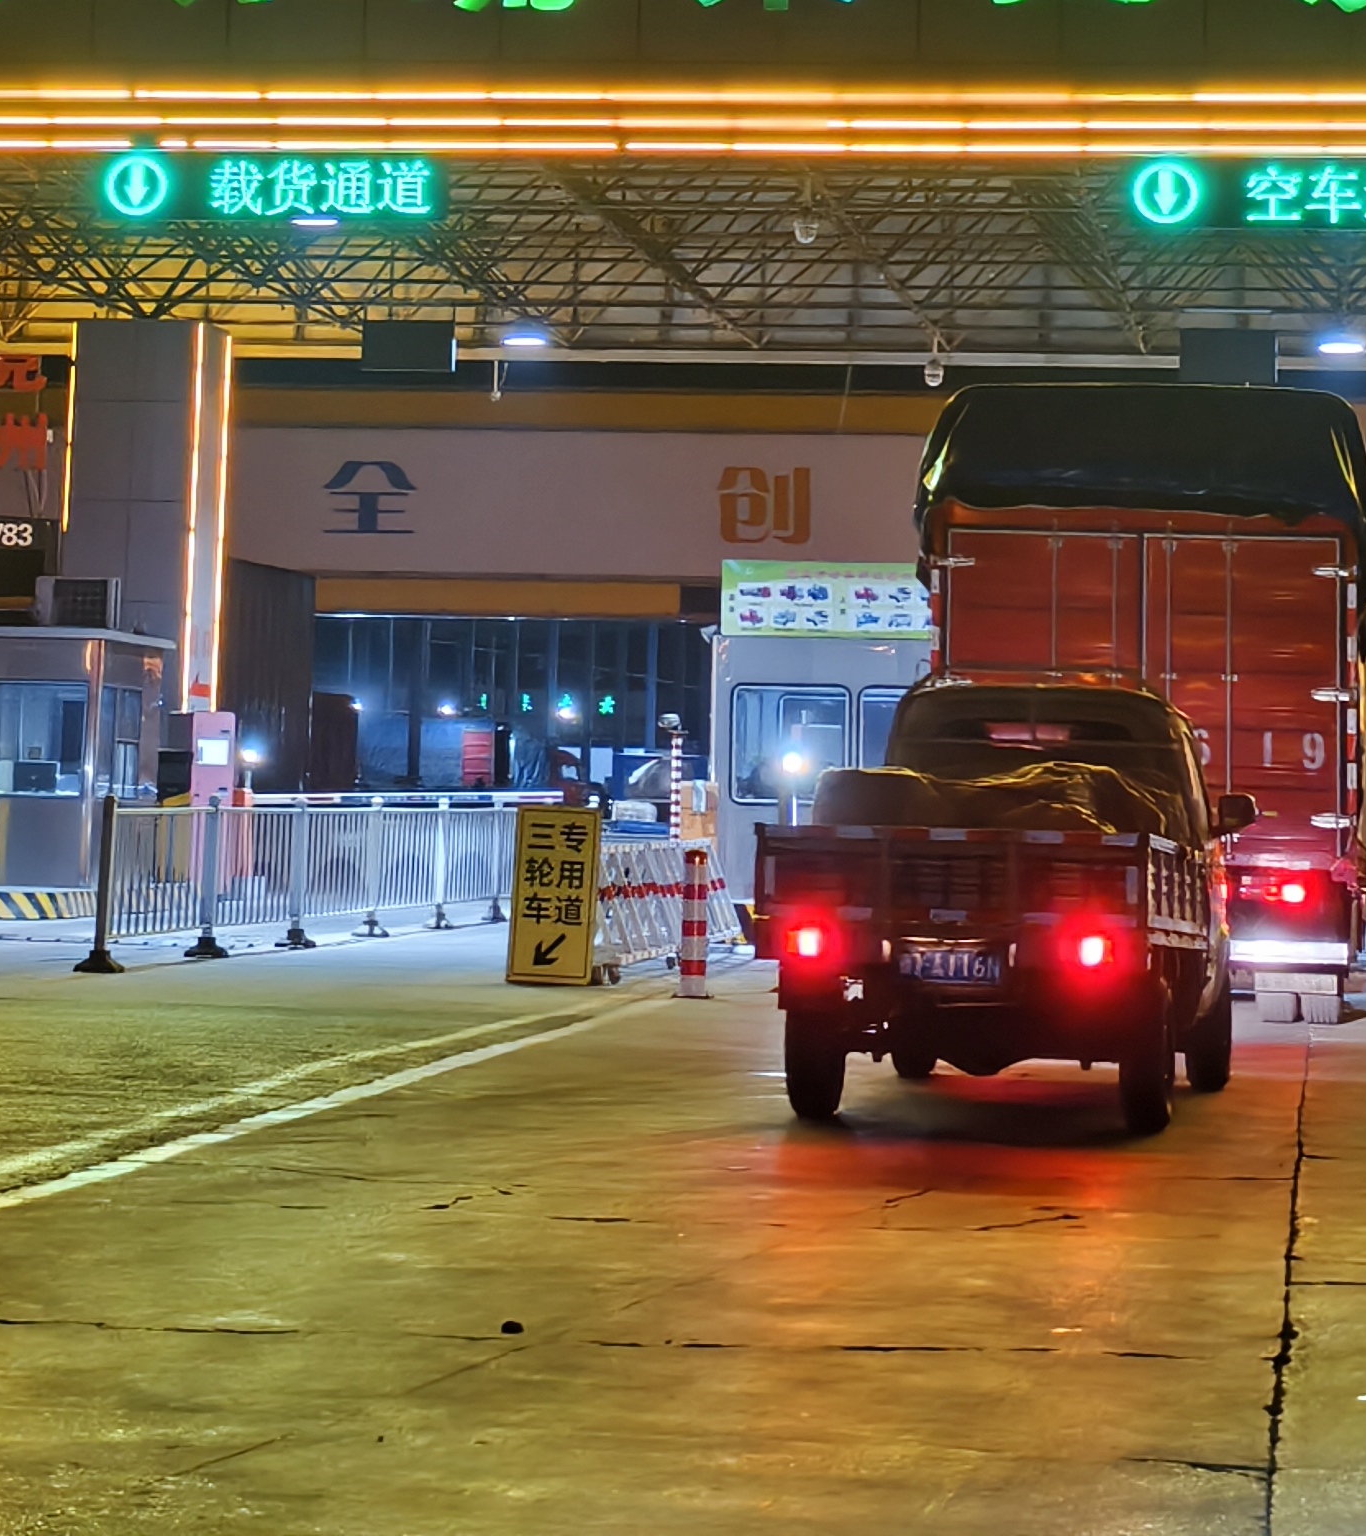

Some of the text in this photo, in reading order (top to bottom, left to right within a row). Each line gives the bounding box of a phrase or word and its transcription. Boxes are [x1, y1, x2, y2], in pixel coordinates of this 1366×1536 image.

[208, 158, 432, 217] 载货通道
[323, 460, 417, 535] 全
[717, 466, 812, 545] 创
[522, 821, 556, 926] 三轮车
[552, 821, 589, 927] 专用道
